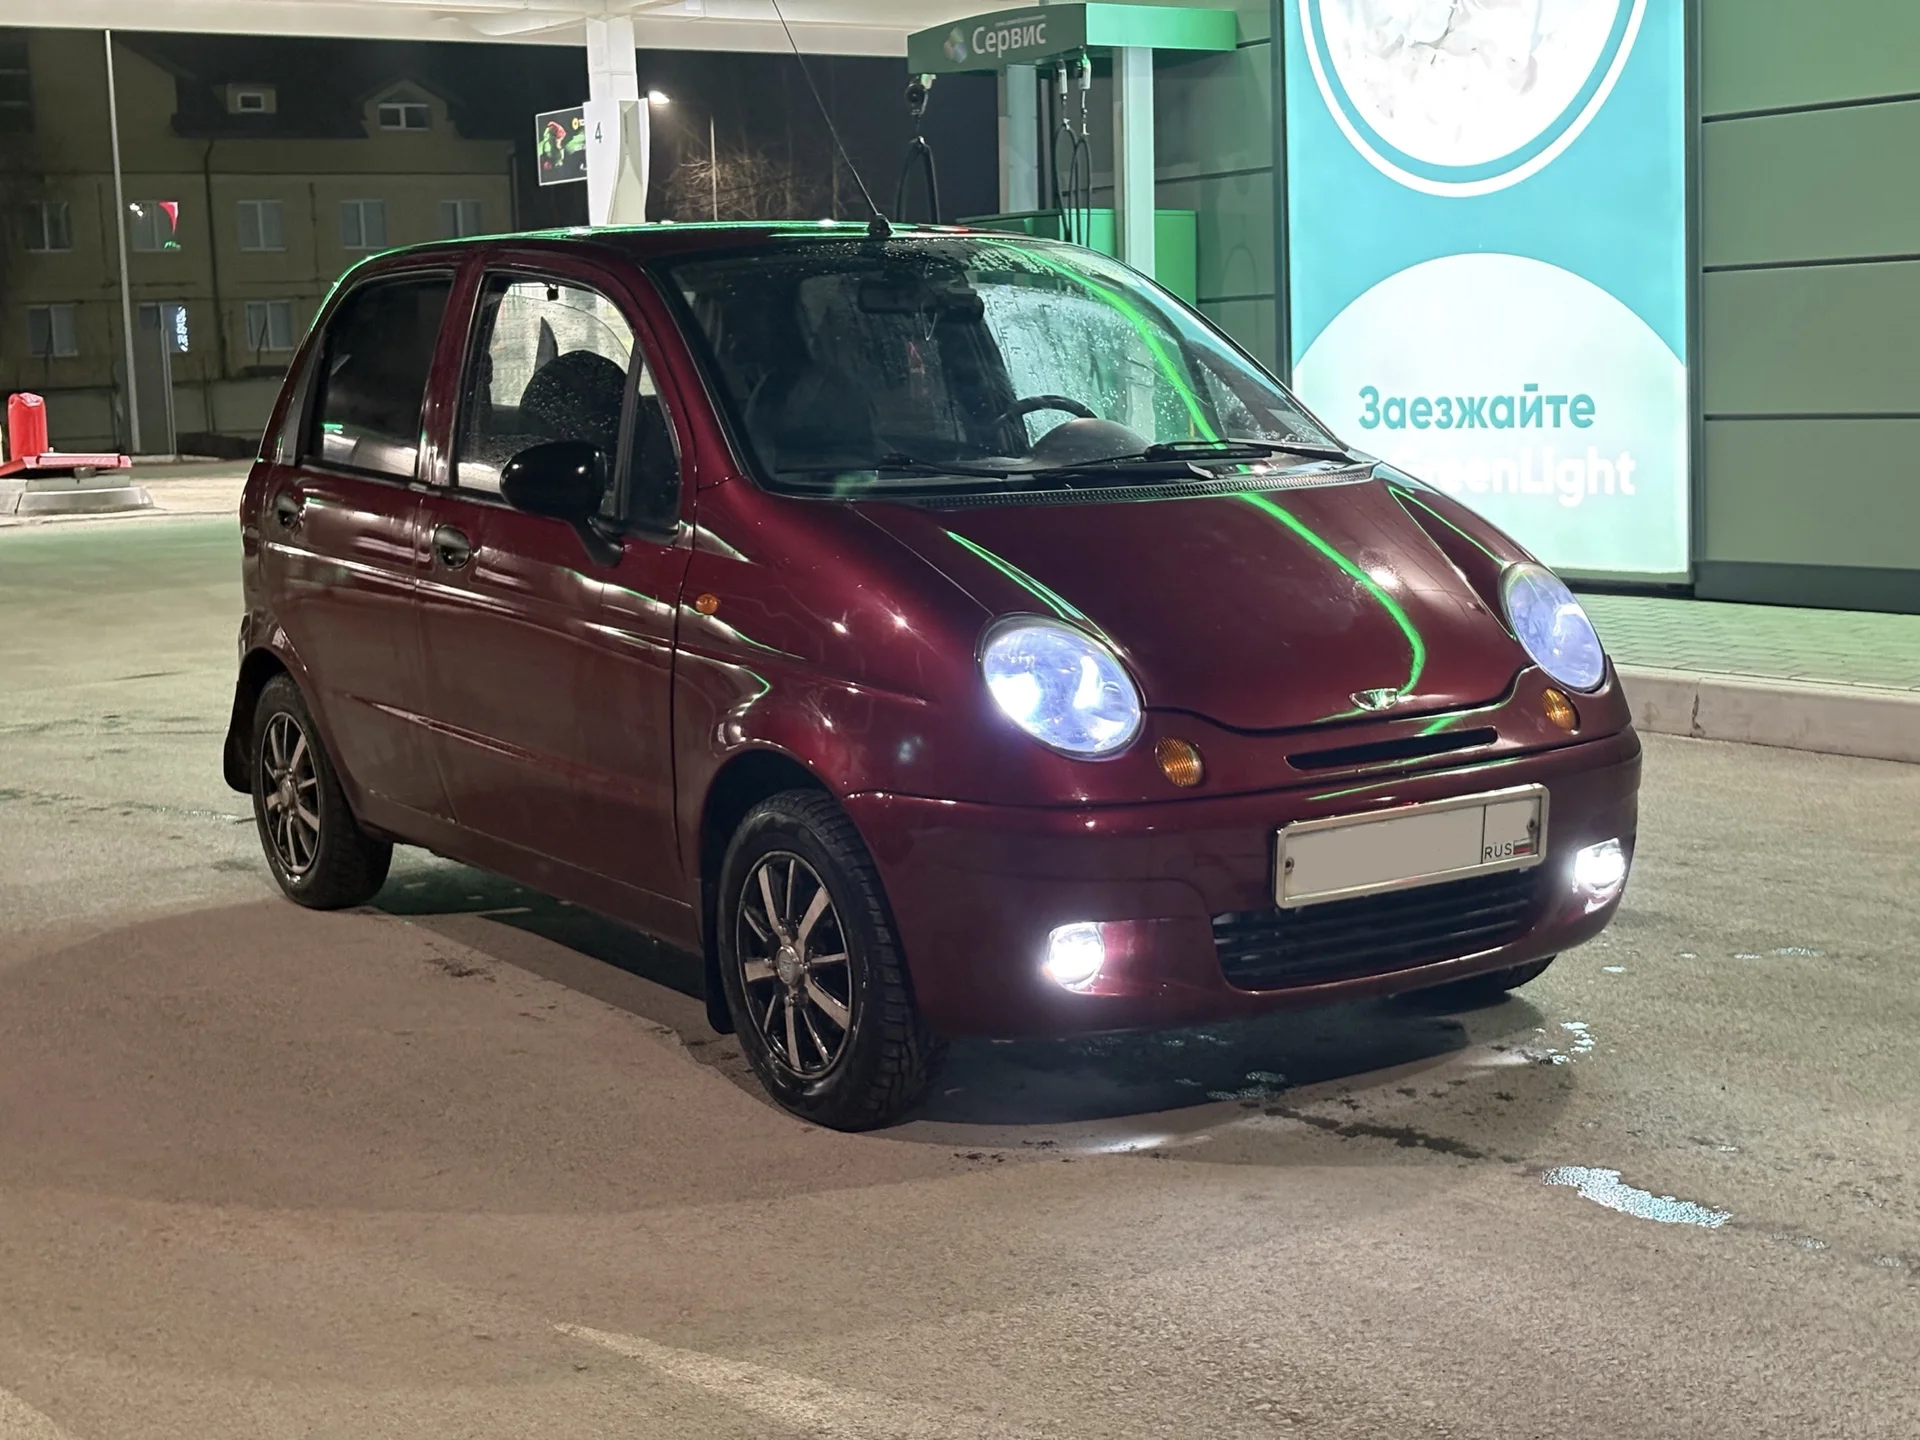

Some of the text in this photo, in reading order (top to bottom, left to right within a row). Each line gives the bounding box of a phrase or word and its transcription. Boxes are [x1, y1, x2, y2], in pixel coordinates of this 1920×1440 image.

[972, 23, 1046, 58] Сервис
[595, 121, 603, 143] 4
[1358, 383, 1596, 429] Заезжайте
[1484, 842, 1512, 859] RUS
